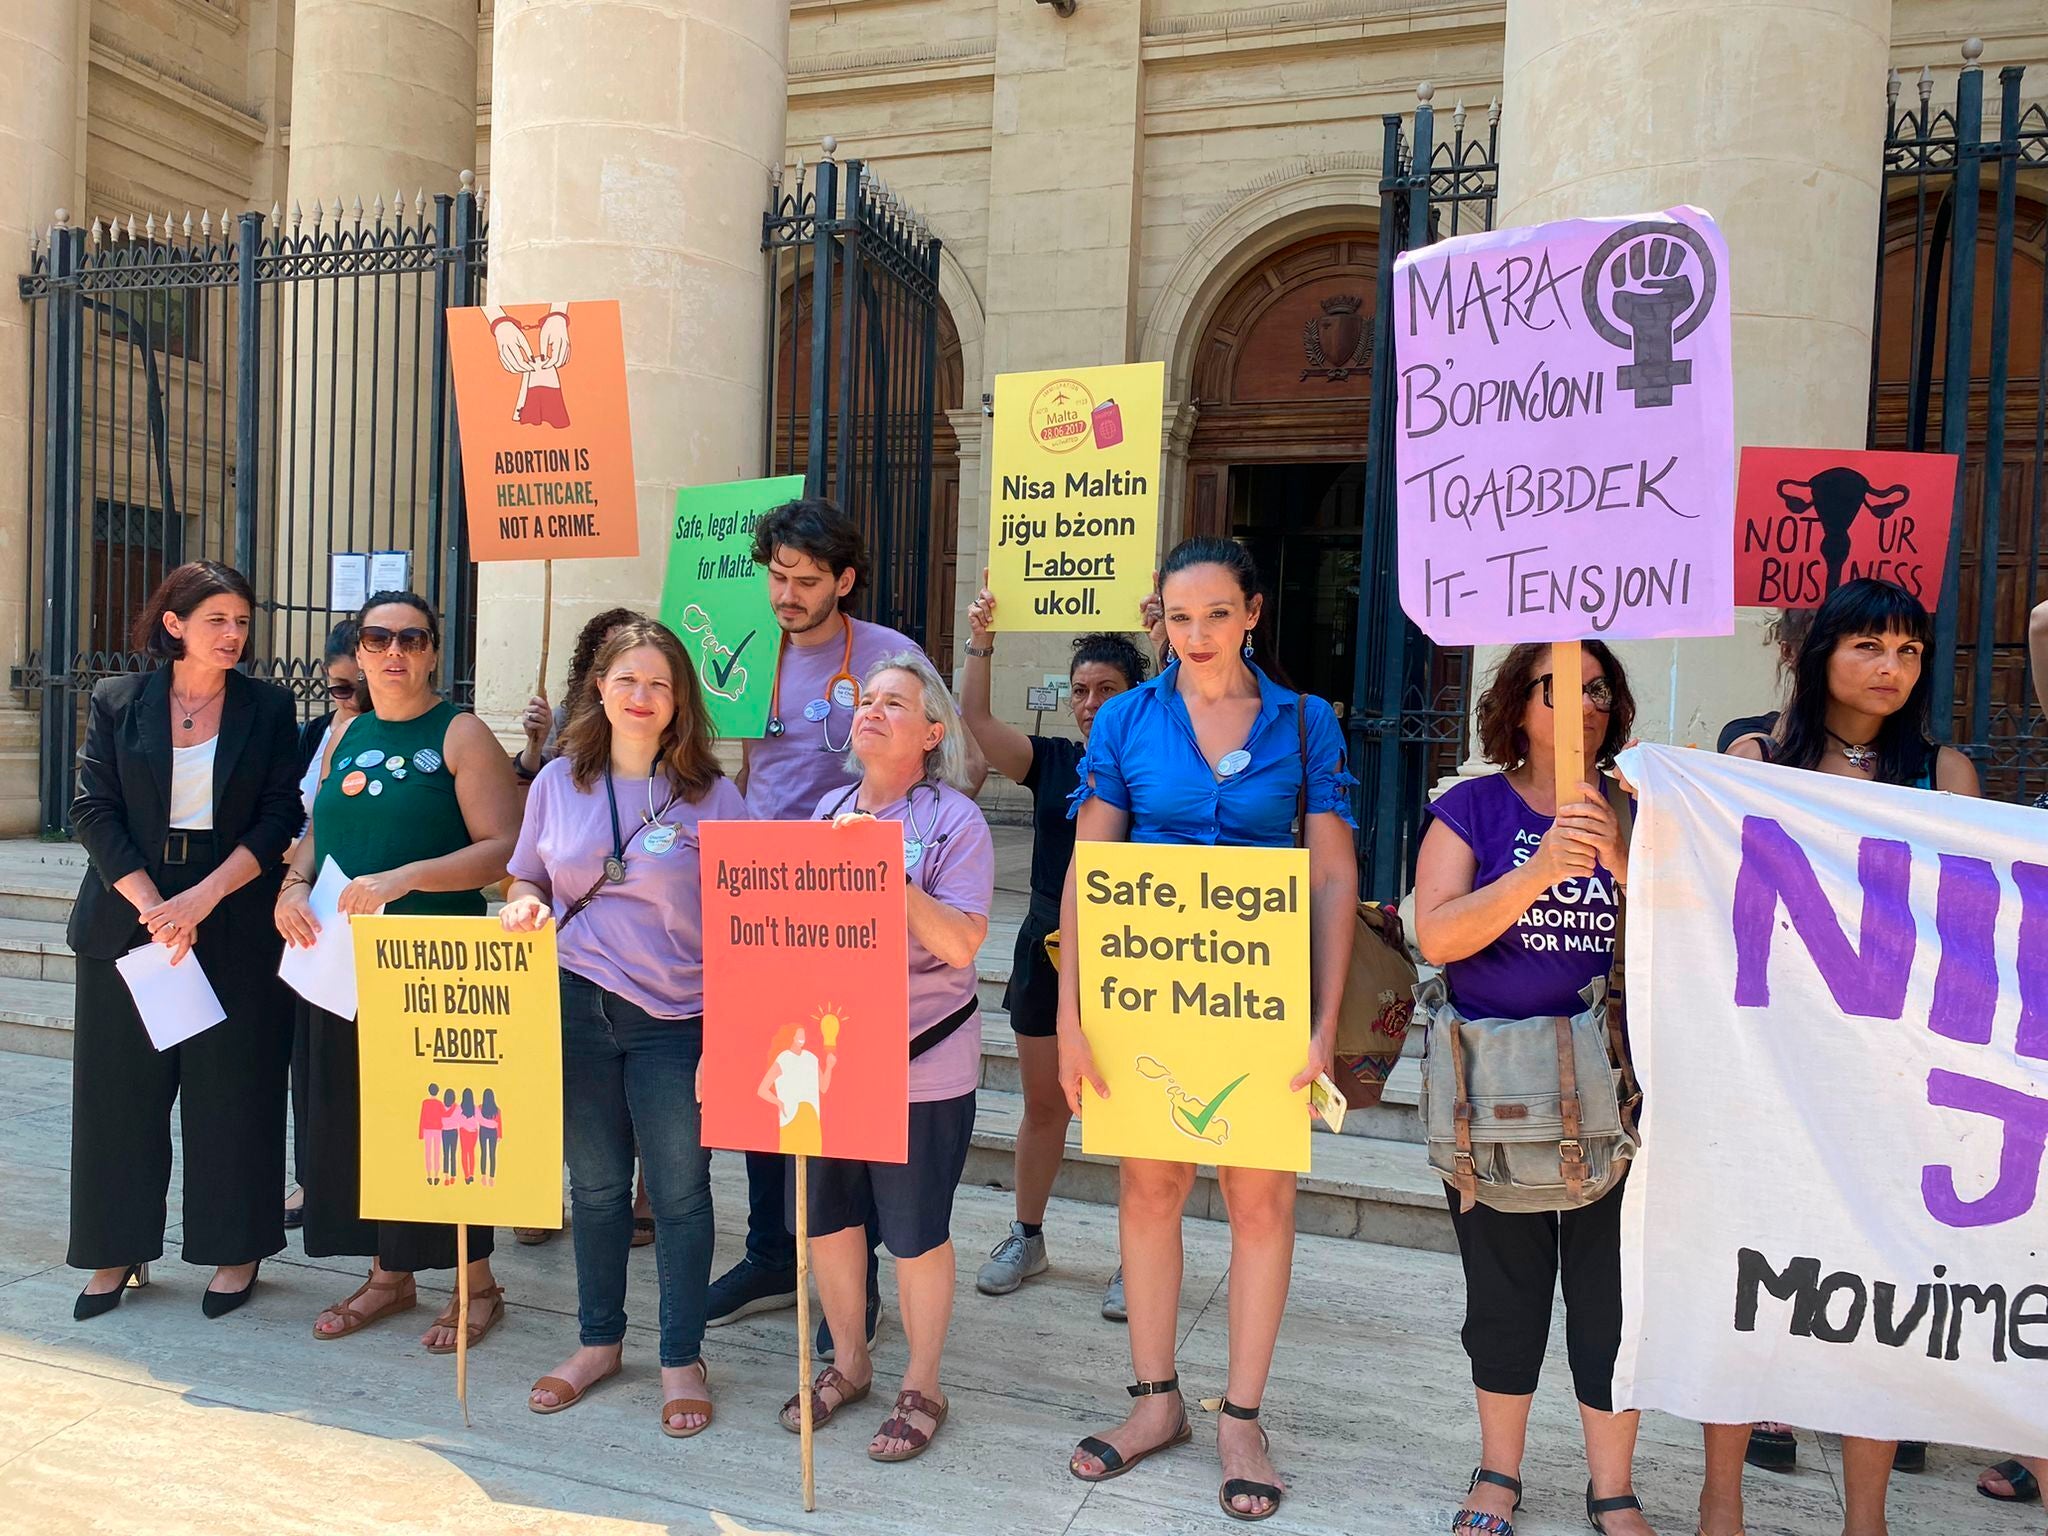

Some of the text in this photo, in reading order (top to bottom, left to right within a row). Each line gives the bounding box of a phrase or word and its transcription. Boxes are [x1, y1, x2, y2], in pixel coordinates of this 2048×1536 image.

[1407, 246, 1582, 345] MARA
[1047, 410, 1078, 425] Malta
[495, 448, 590, 474] ABORTION IS
[496, 481, 599, 507] HEALTHCARE,
[1002, 469, 1147, 500] Nisa Maltin
[1404, 455, 1700, 532] TQABBDEK
[499, 514, 600, 539] NOT A CRIME.
[675, 514, 704, 541] Safe,
[707, 511, 738, 542] legal
[998, 512, 1135, 546] jiġu bżonn
[1744, 516, 1918, 554] NOT UR
[697, 553, 756, 580] for Malta.
[1024, 550, 1115, 577] l-abort
[1034, 587, 1101, 615] ukoll.
[716, 860, 888, 897] Against abortion?
[1086, 869, 1297, 922] Safe, legal
[730, 915, 877, 950] Don't have one!
[1517, 909, 1618, 932] ABORTIO
[376, 939, 533, 972] KULĦADD JISTA'
[1100, 924, 1270, 966] abortion
[1521, 933, 1616, 953] FOR MALT
[404, 976, 510, 1015] JIĠI BŻONN
[1100, 976, 1285, 1021] for Malta
[415, 1026, 503, 1060] L-ABORT.
